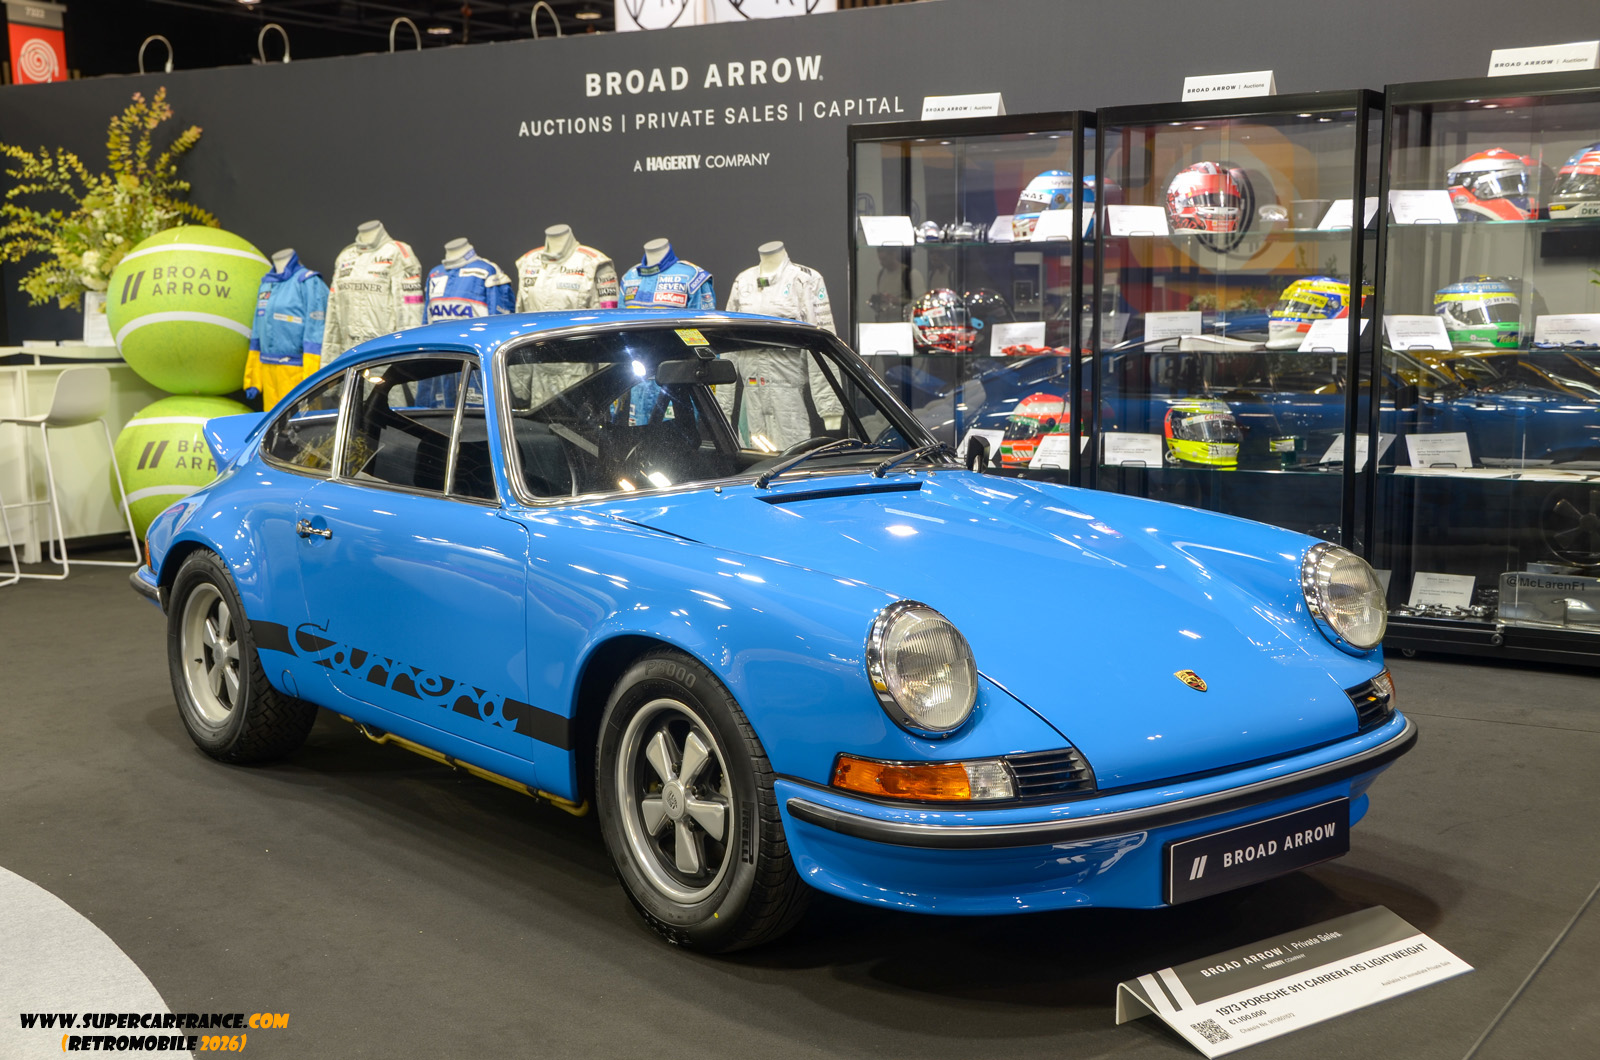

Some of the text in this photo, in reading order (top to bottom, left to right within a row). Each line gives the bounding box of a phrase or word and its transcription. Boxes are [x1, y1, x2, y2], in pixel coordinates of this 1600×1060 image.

[586, 55, 822, 97] BROAD ARROW
[519, 96, 904, 137] AUCTIONS PRIVATE SALES CAPITAL
[633, 153, 770, 172] A HAGERTY COMPANY
[1581, 207, 1599, 215] DEK
[153, 266, 228, 282] BROAD
[152, 282, 232, 298] ARROW
[659, 283, 685, 291] SEVEN
[175, 455, 217, 471] ARR
[1506, 576, 1586, 591] @McLarenF1
[288, 619, 519, 732] Carrera
[645, 661, 697, 688] P6000
[1223, 822, 1336, 868] BROAD ARROW
[1200, 960, 1241, 978] BROAD
[1243, 947, 1283, 965] ARROW
[1290, 937, 1319, 950] Private
[1216, 943, 1428, 1016] 1973 PORSCHE 911 CARRERA RS LIGHTWEIGHT
[1228, 1009, 1267, 1025] €1.100.000
